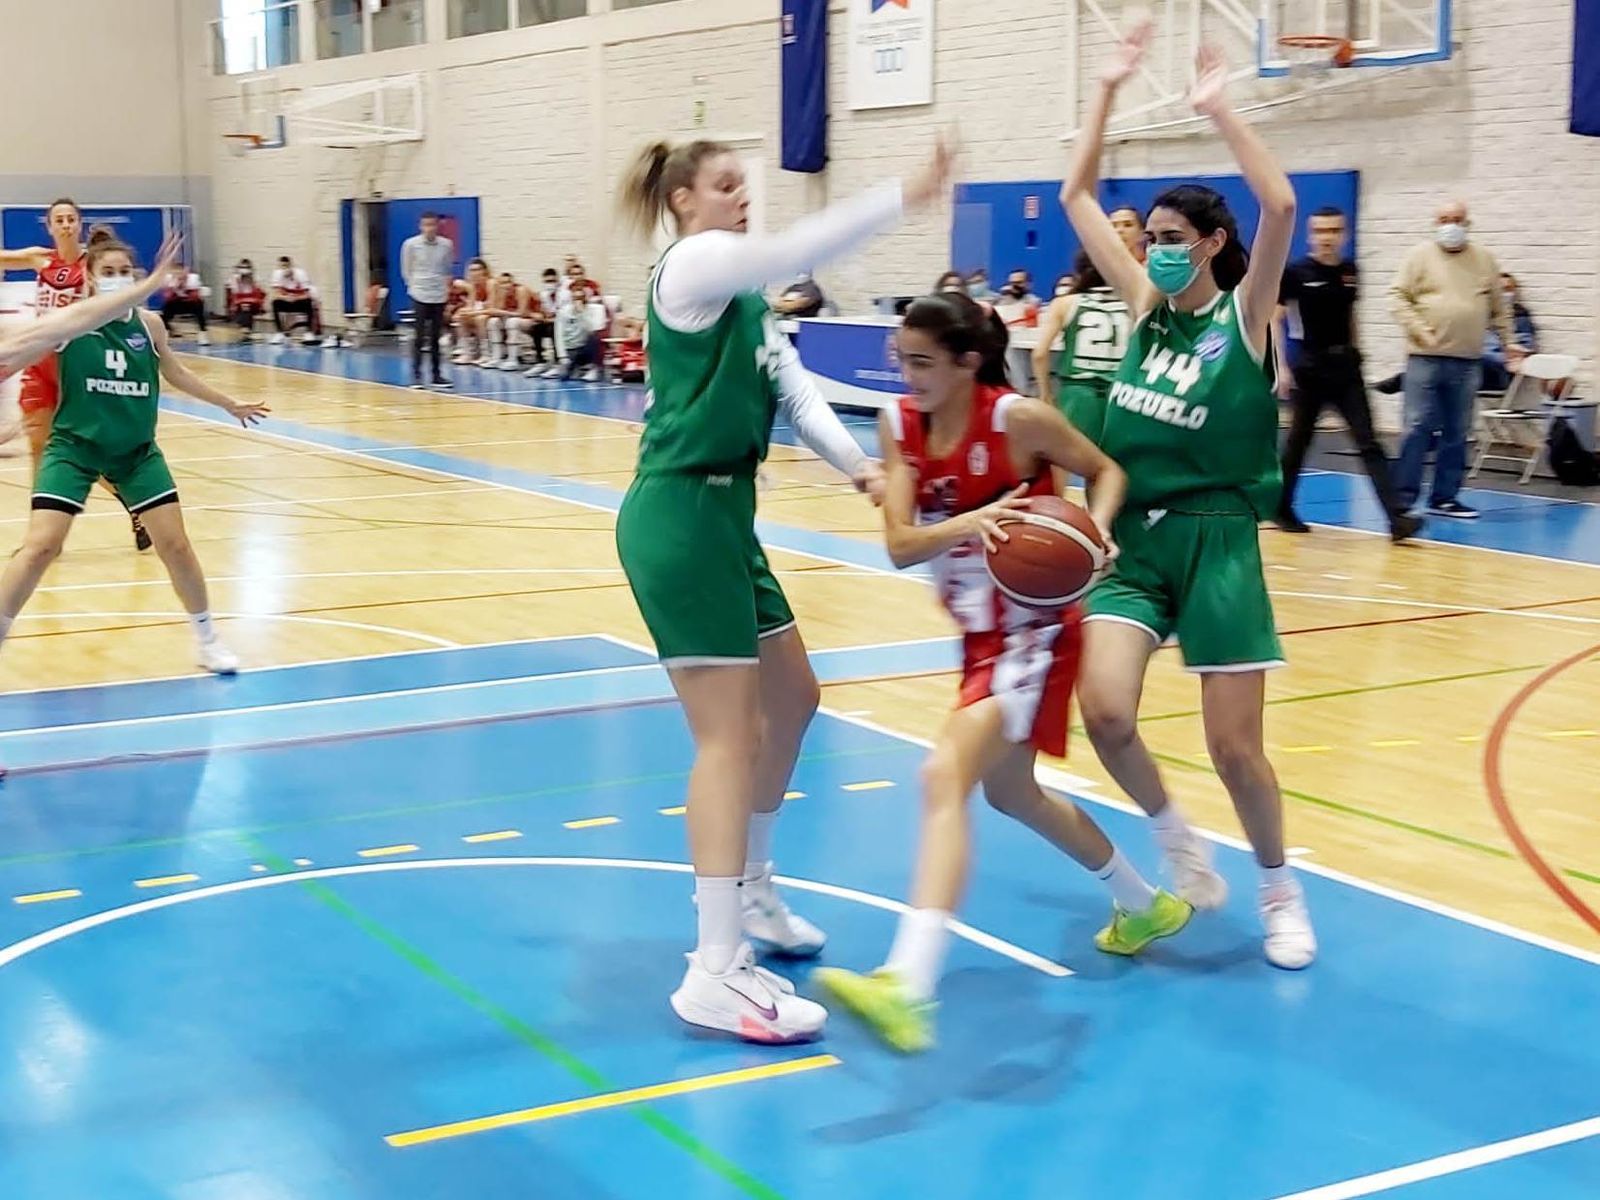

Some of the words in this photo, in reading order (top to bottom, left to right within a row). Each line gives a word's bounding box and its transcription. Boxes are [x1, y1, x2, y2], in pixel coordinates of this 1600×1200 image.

[55, 268, 69, 283] 6
[1074, 310, 1129, 359] 21
[105, 349, 128, 378] 4
[1140, 343, 1202, 396] 44
[86, 378, 150, 396] POZUELO
